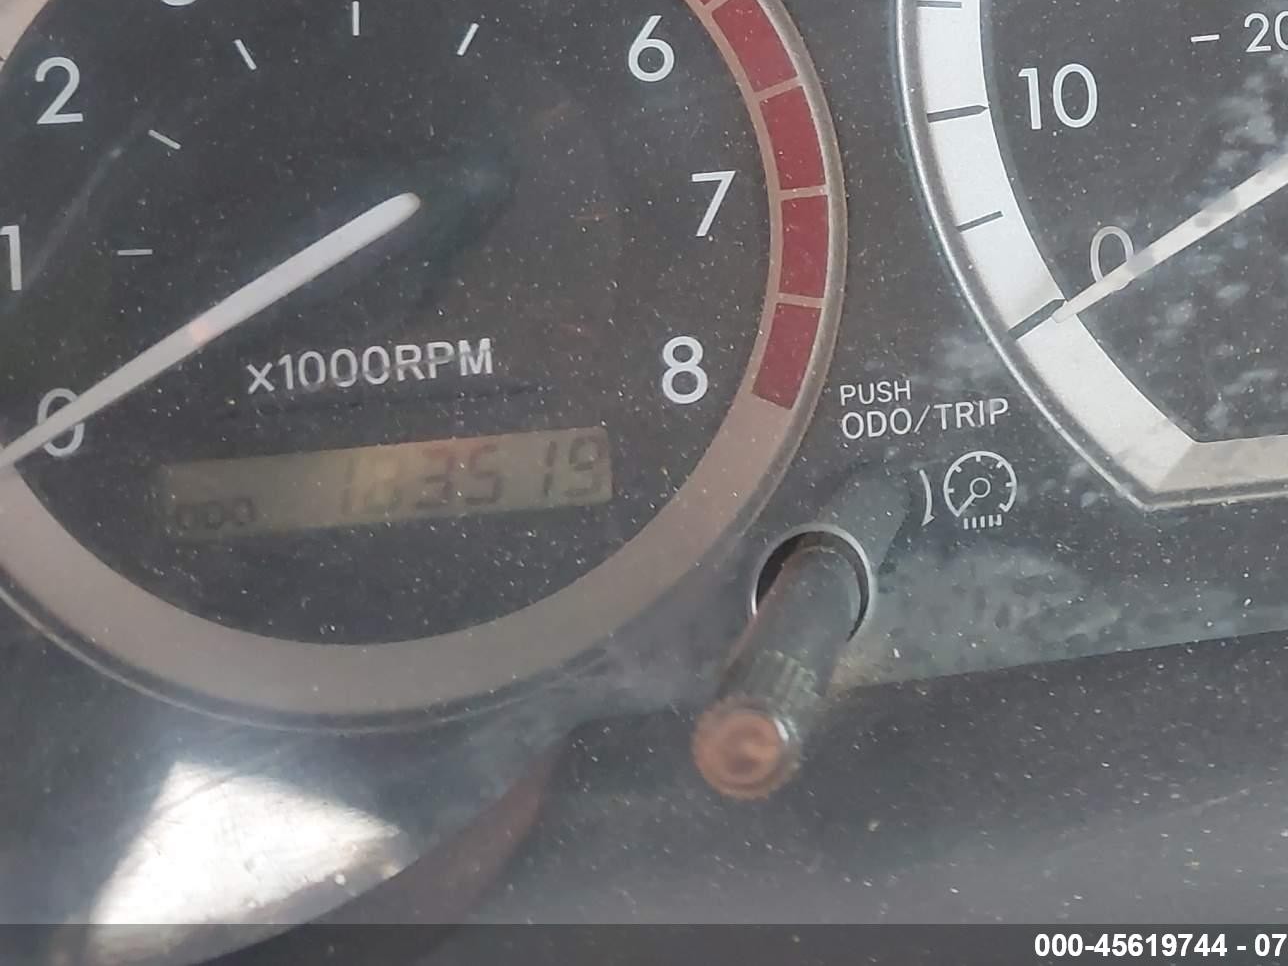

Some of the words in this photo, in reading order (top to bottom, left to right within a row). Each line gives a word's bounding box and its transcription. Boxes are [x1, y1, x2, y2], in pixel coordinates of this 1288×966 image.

[628, 15, 675, 82] 6
[35, 57, 83, 124] 2
[1018, 63, 1098, 131] 10
[692, 170, 737, 237] 7
[0, 225, 21, 290] 1
[1090, 226, 1135, 291] 0
[662, 336, 708, 404] 8
[839, 380, 912, 406] PUSH
[841, 398, 1009, 440] ODO/TRIP
